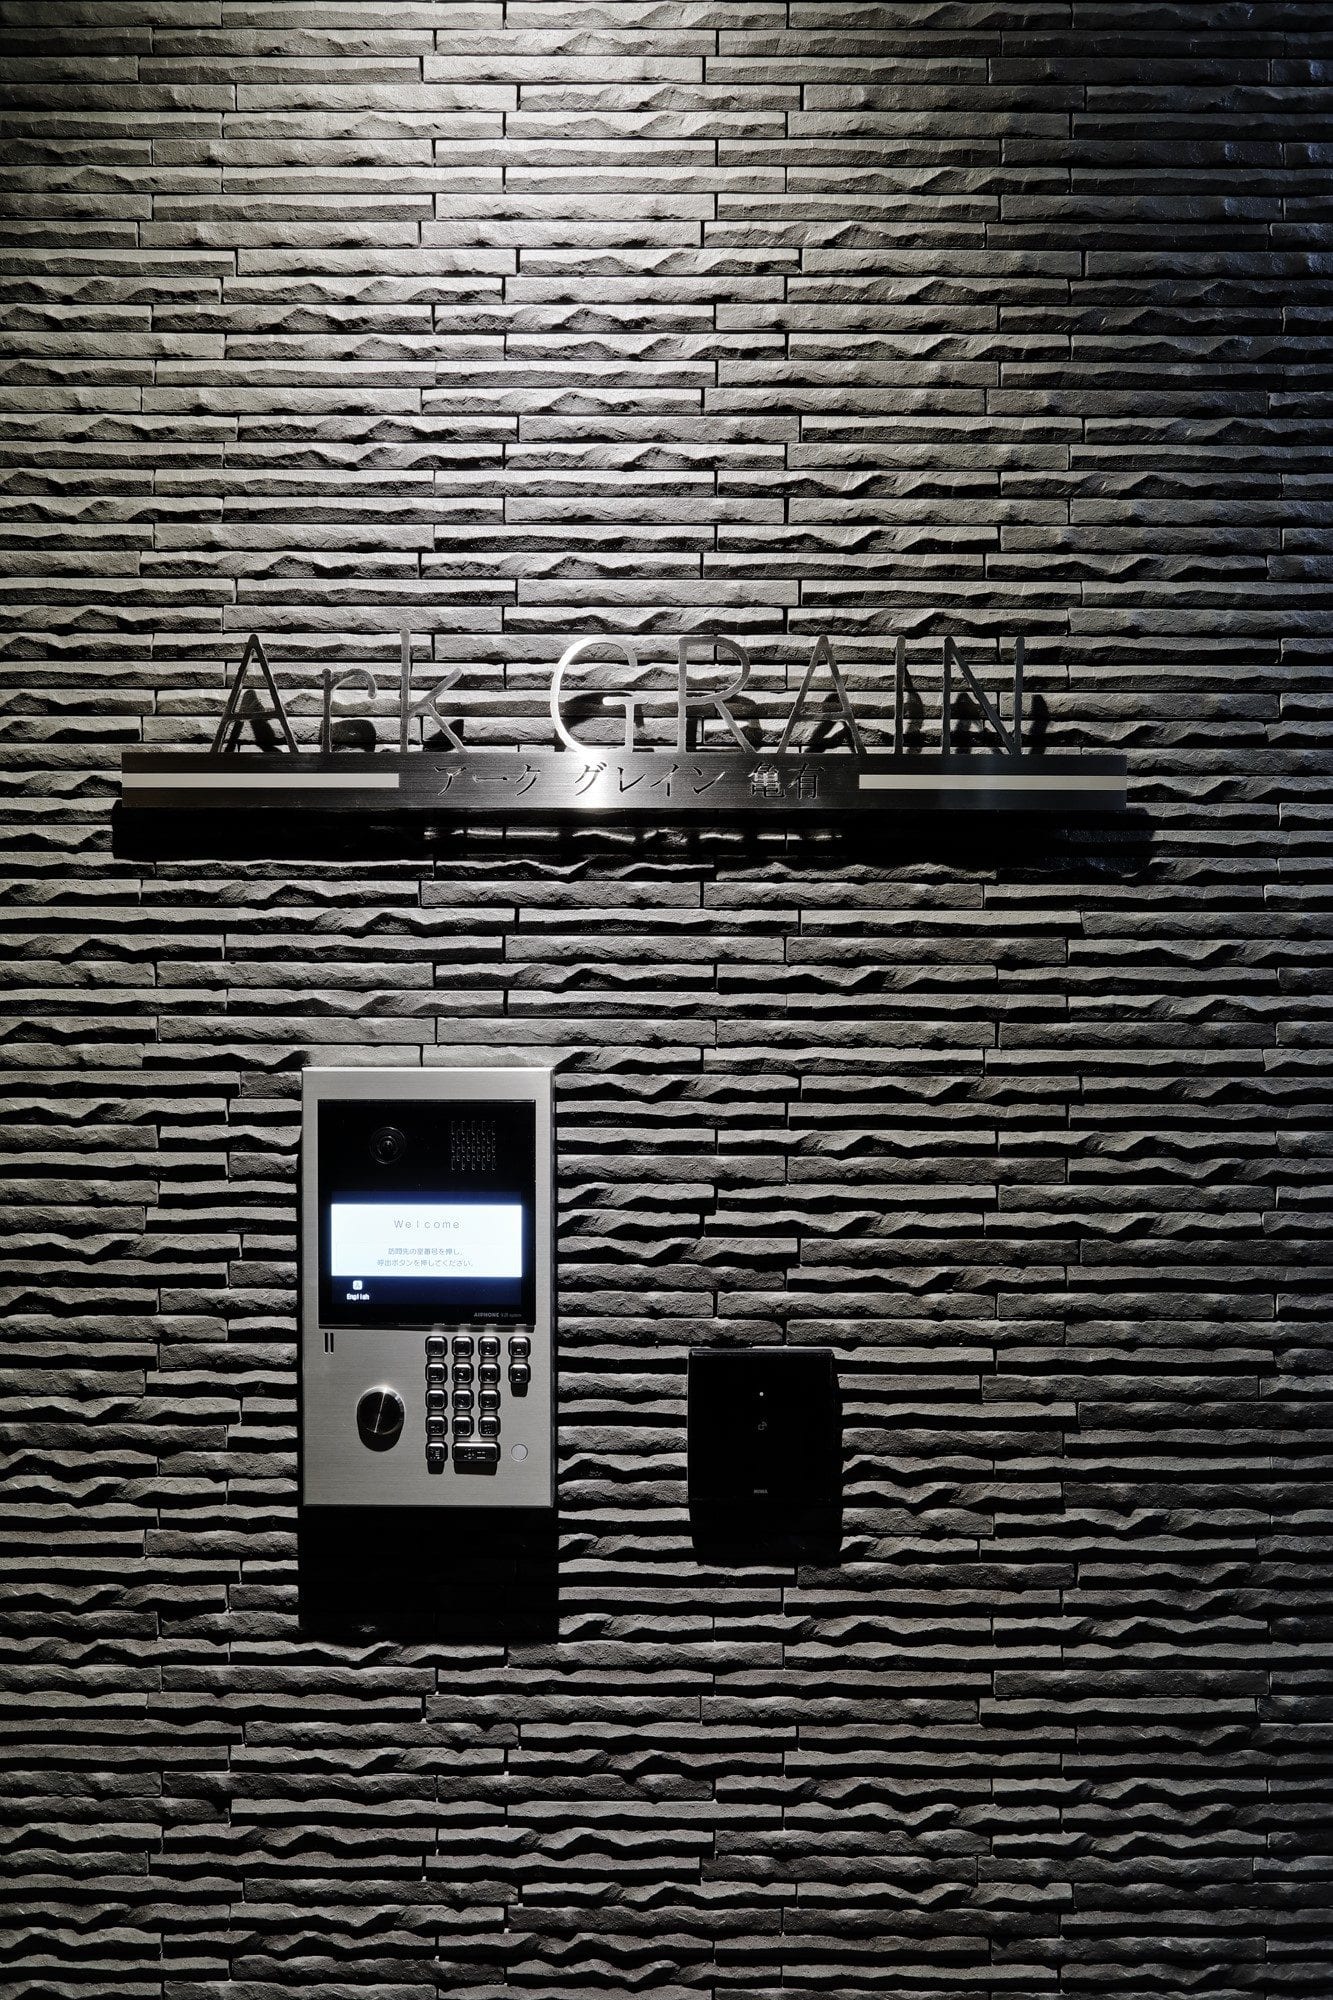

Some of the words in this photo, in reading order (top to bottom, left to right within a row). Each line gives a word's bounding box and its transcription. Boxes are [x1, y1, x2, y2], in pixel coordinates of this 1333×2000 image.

[210, 627, 468, 753] Ark
[549, 633, 1026, 756] GRAIN
[433, 763, 543, 798] アーク
[574, 760, 727, 798] グレイン
[747, 761, 826, 800] 亀有
[393, 1219, 461, 1229] Welcome
